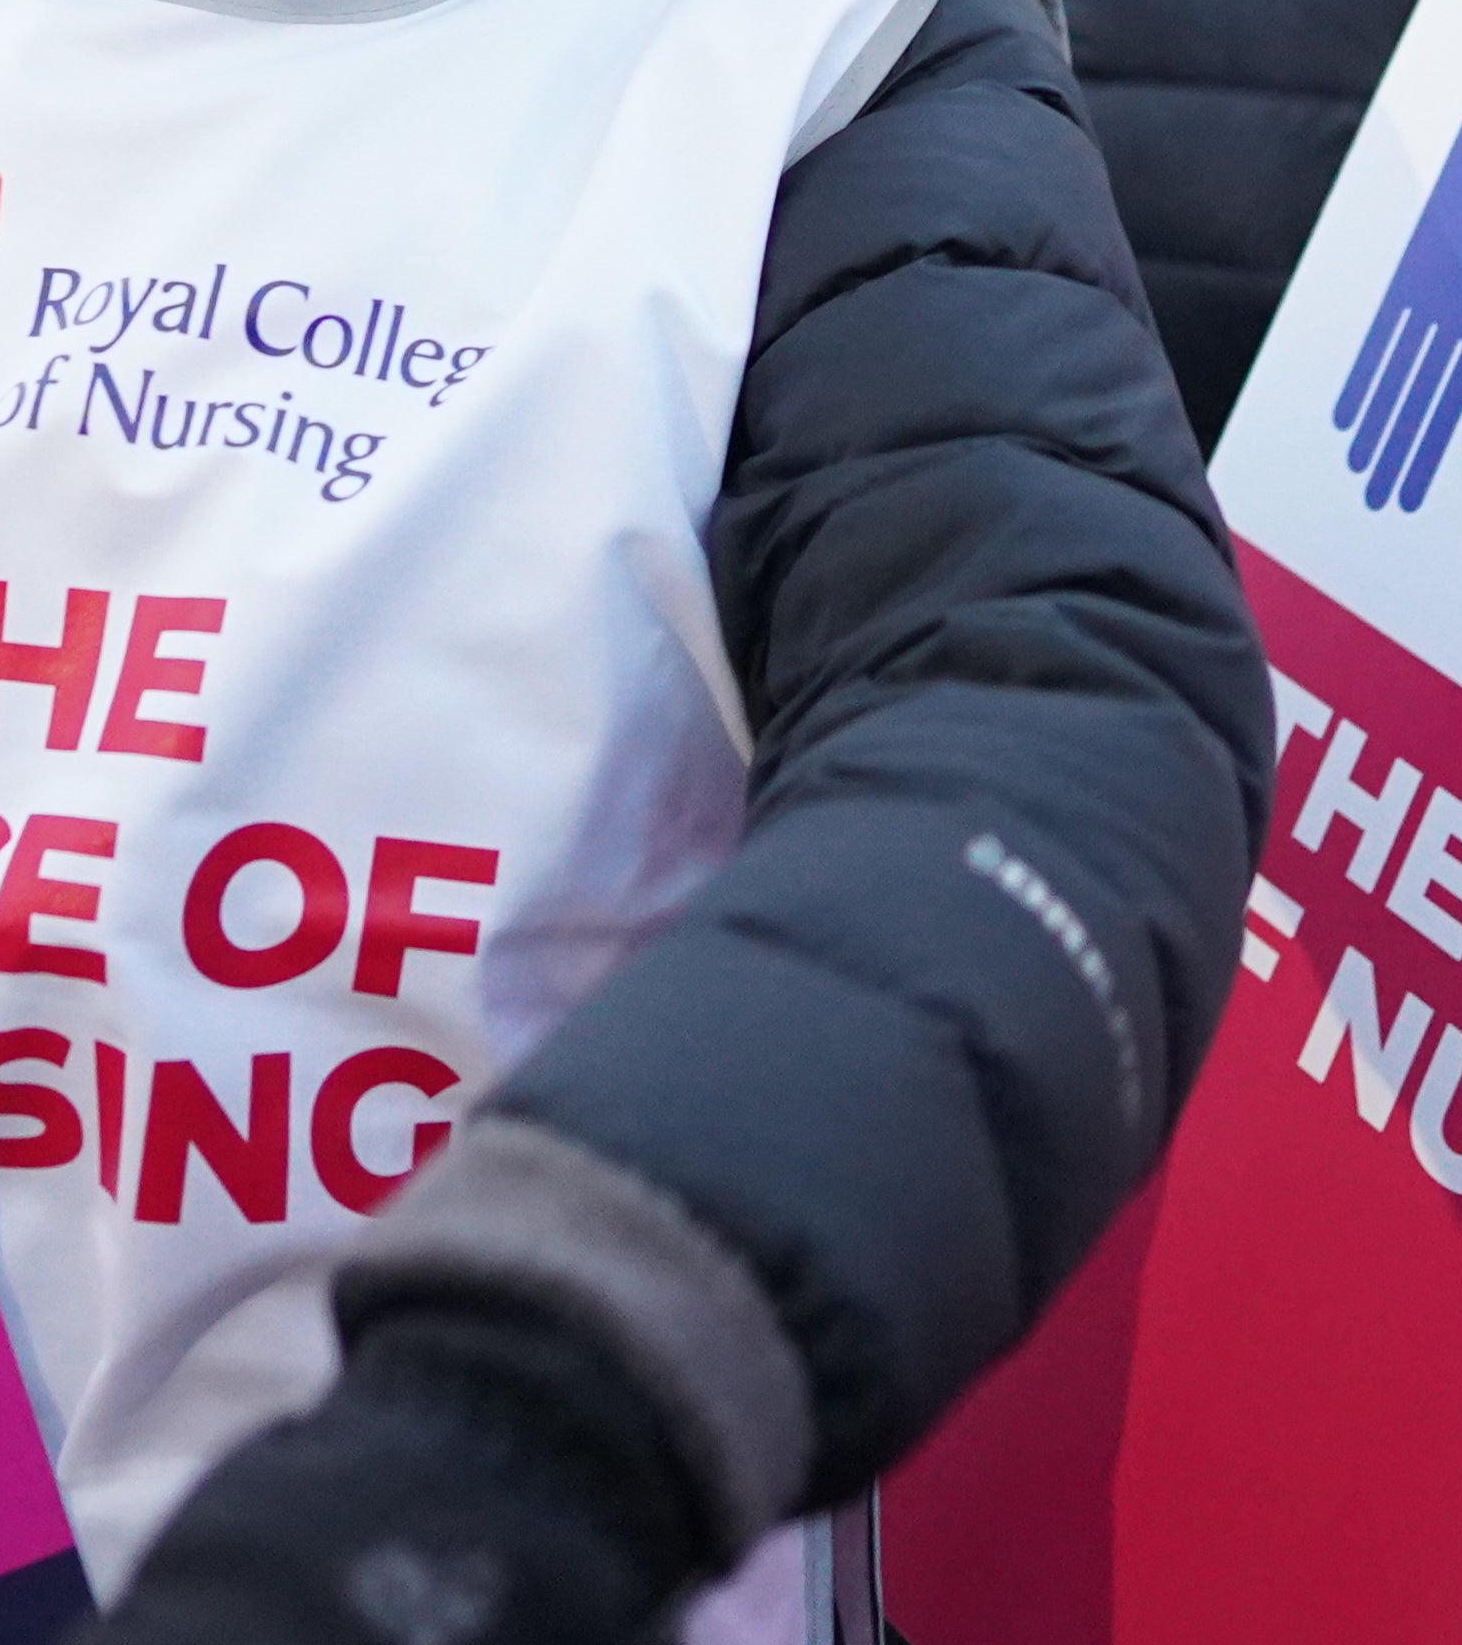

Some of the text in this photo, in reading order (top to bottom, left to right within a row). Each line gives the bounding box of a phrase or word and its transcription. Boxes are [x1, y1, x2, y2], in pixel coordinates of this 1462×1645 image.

[28, 263, 496, 408] Royal Colleg
[77, 361, 387, 504] Nursing
[181, 821, 501, 999] OF
